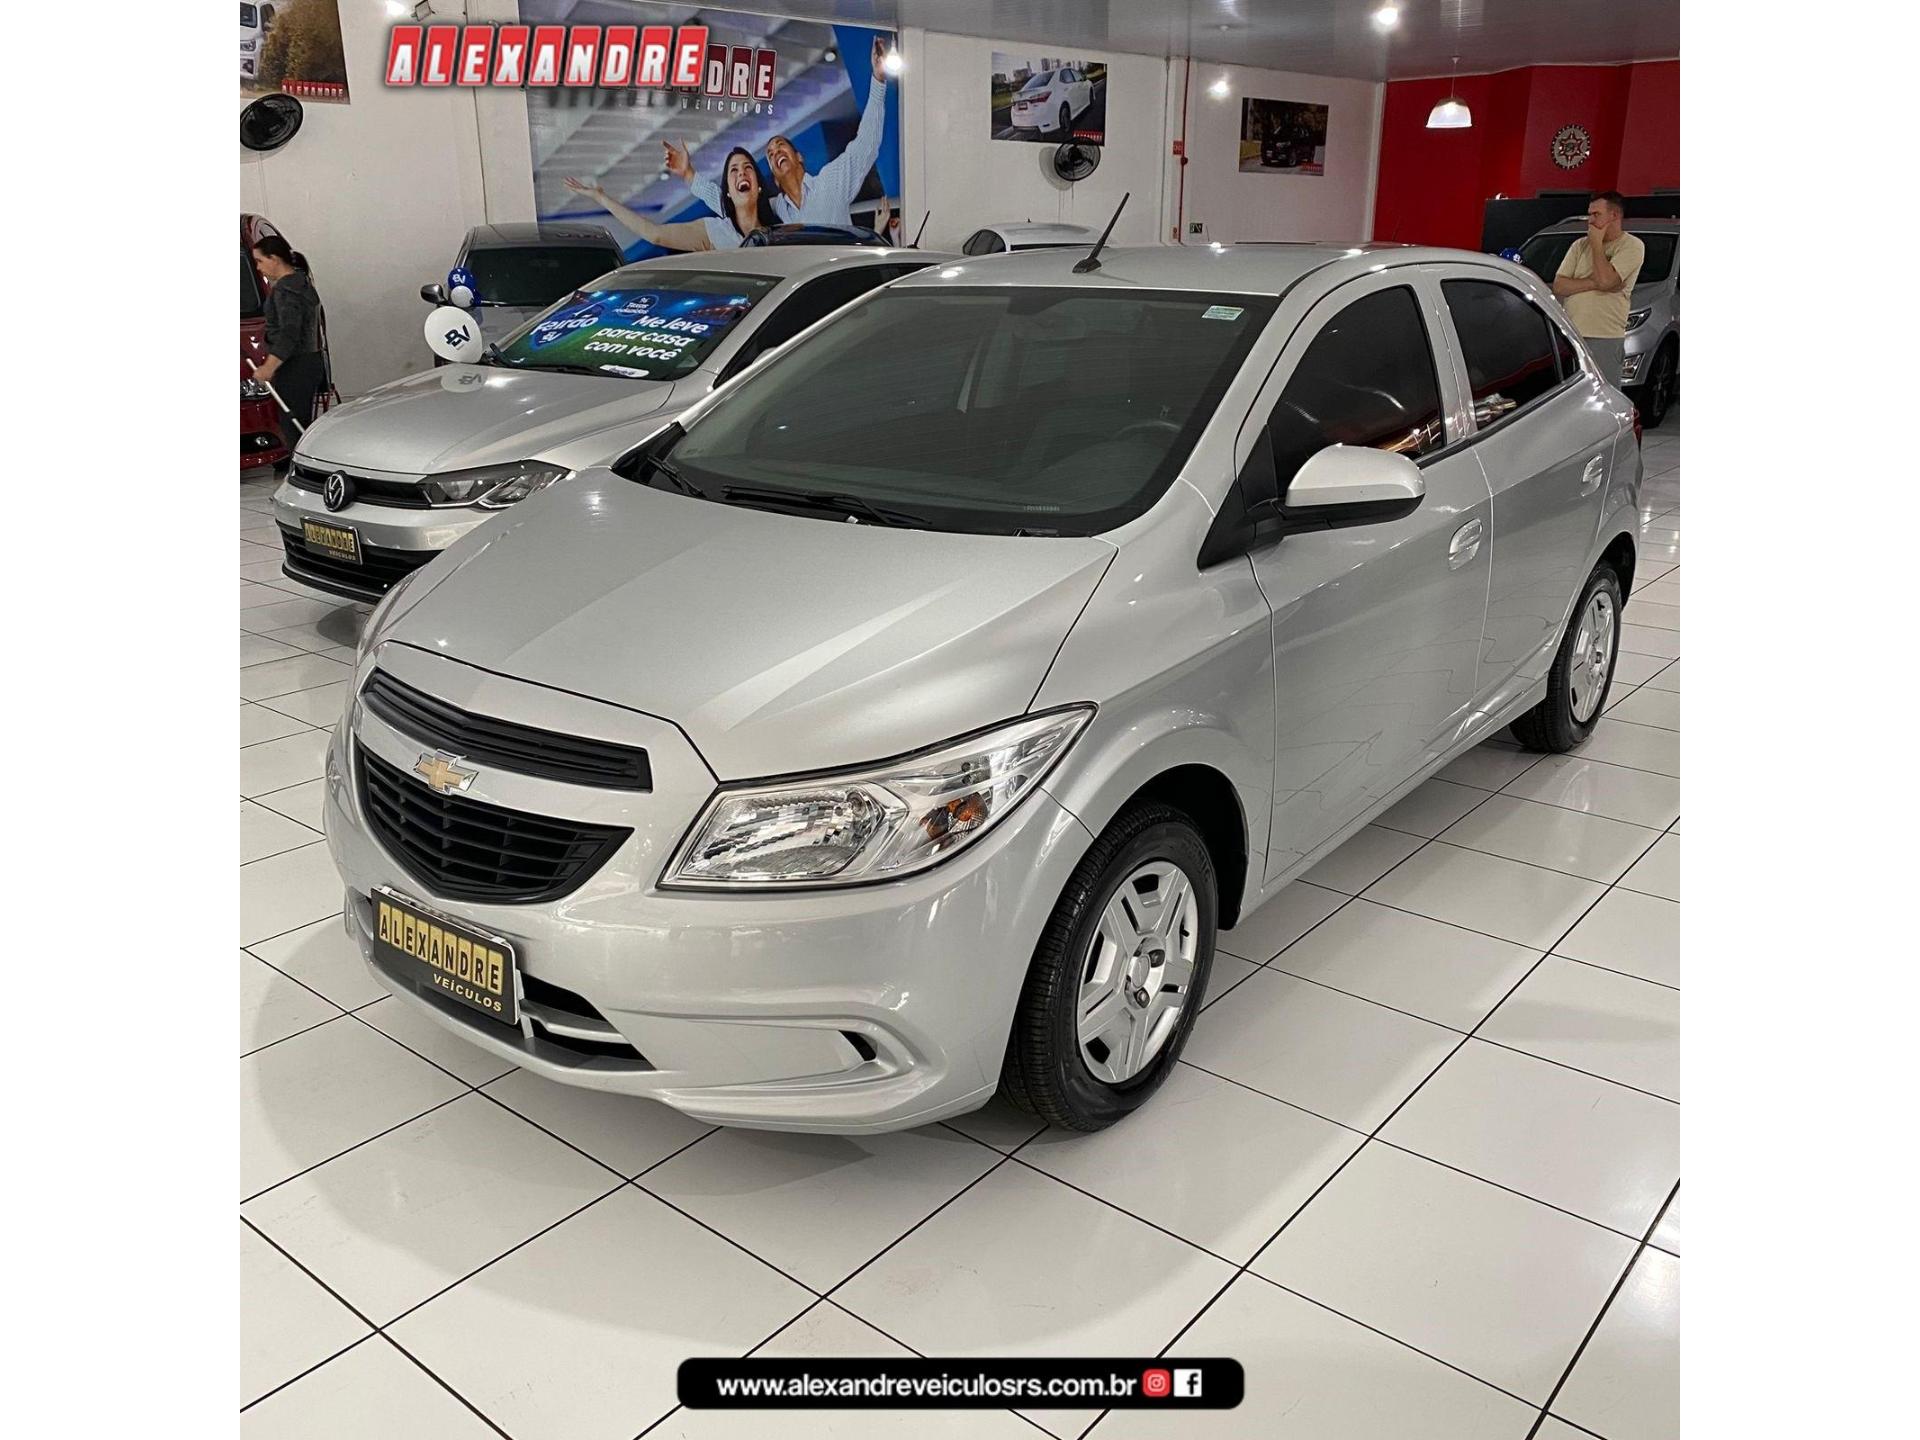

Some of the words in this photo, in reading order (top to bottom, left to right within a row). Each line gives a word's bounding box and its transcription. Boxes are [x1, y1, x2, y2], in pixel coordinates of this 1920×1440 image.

[529, 314, 599, 336] Feirão
[631, 315, 666, 328] Me
[662, 317, 710, 334] leve
[589, 327, 645, 340] para
[641, 332, 696, 348] casa
[584, 341, 628, 354] com
[626, 346, 682, 361] você
[379, 910, 501, 993] ALEXANDRE
[432, 972, 503, 1013] VEÍCULOS
